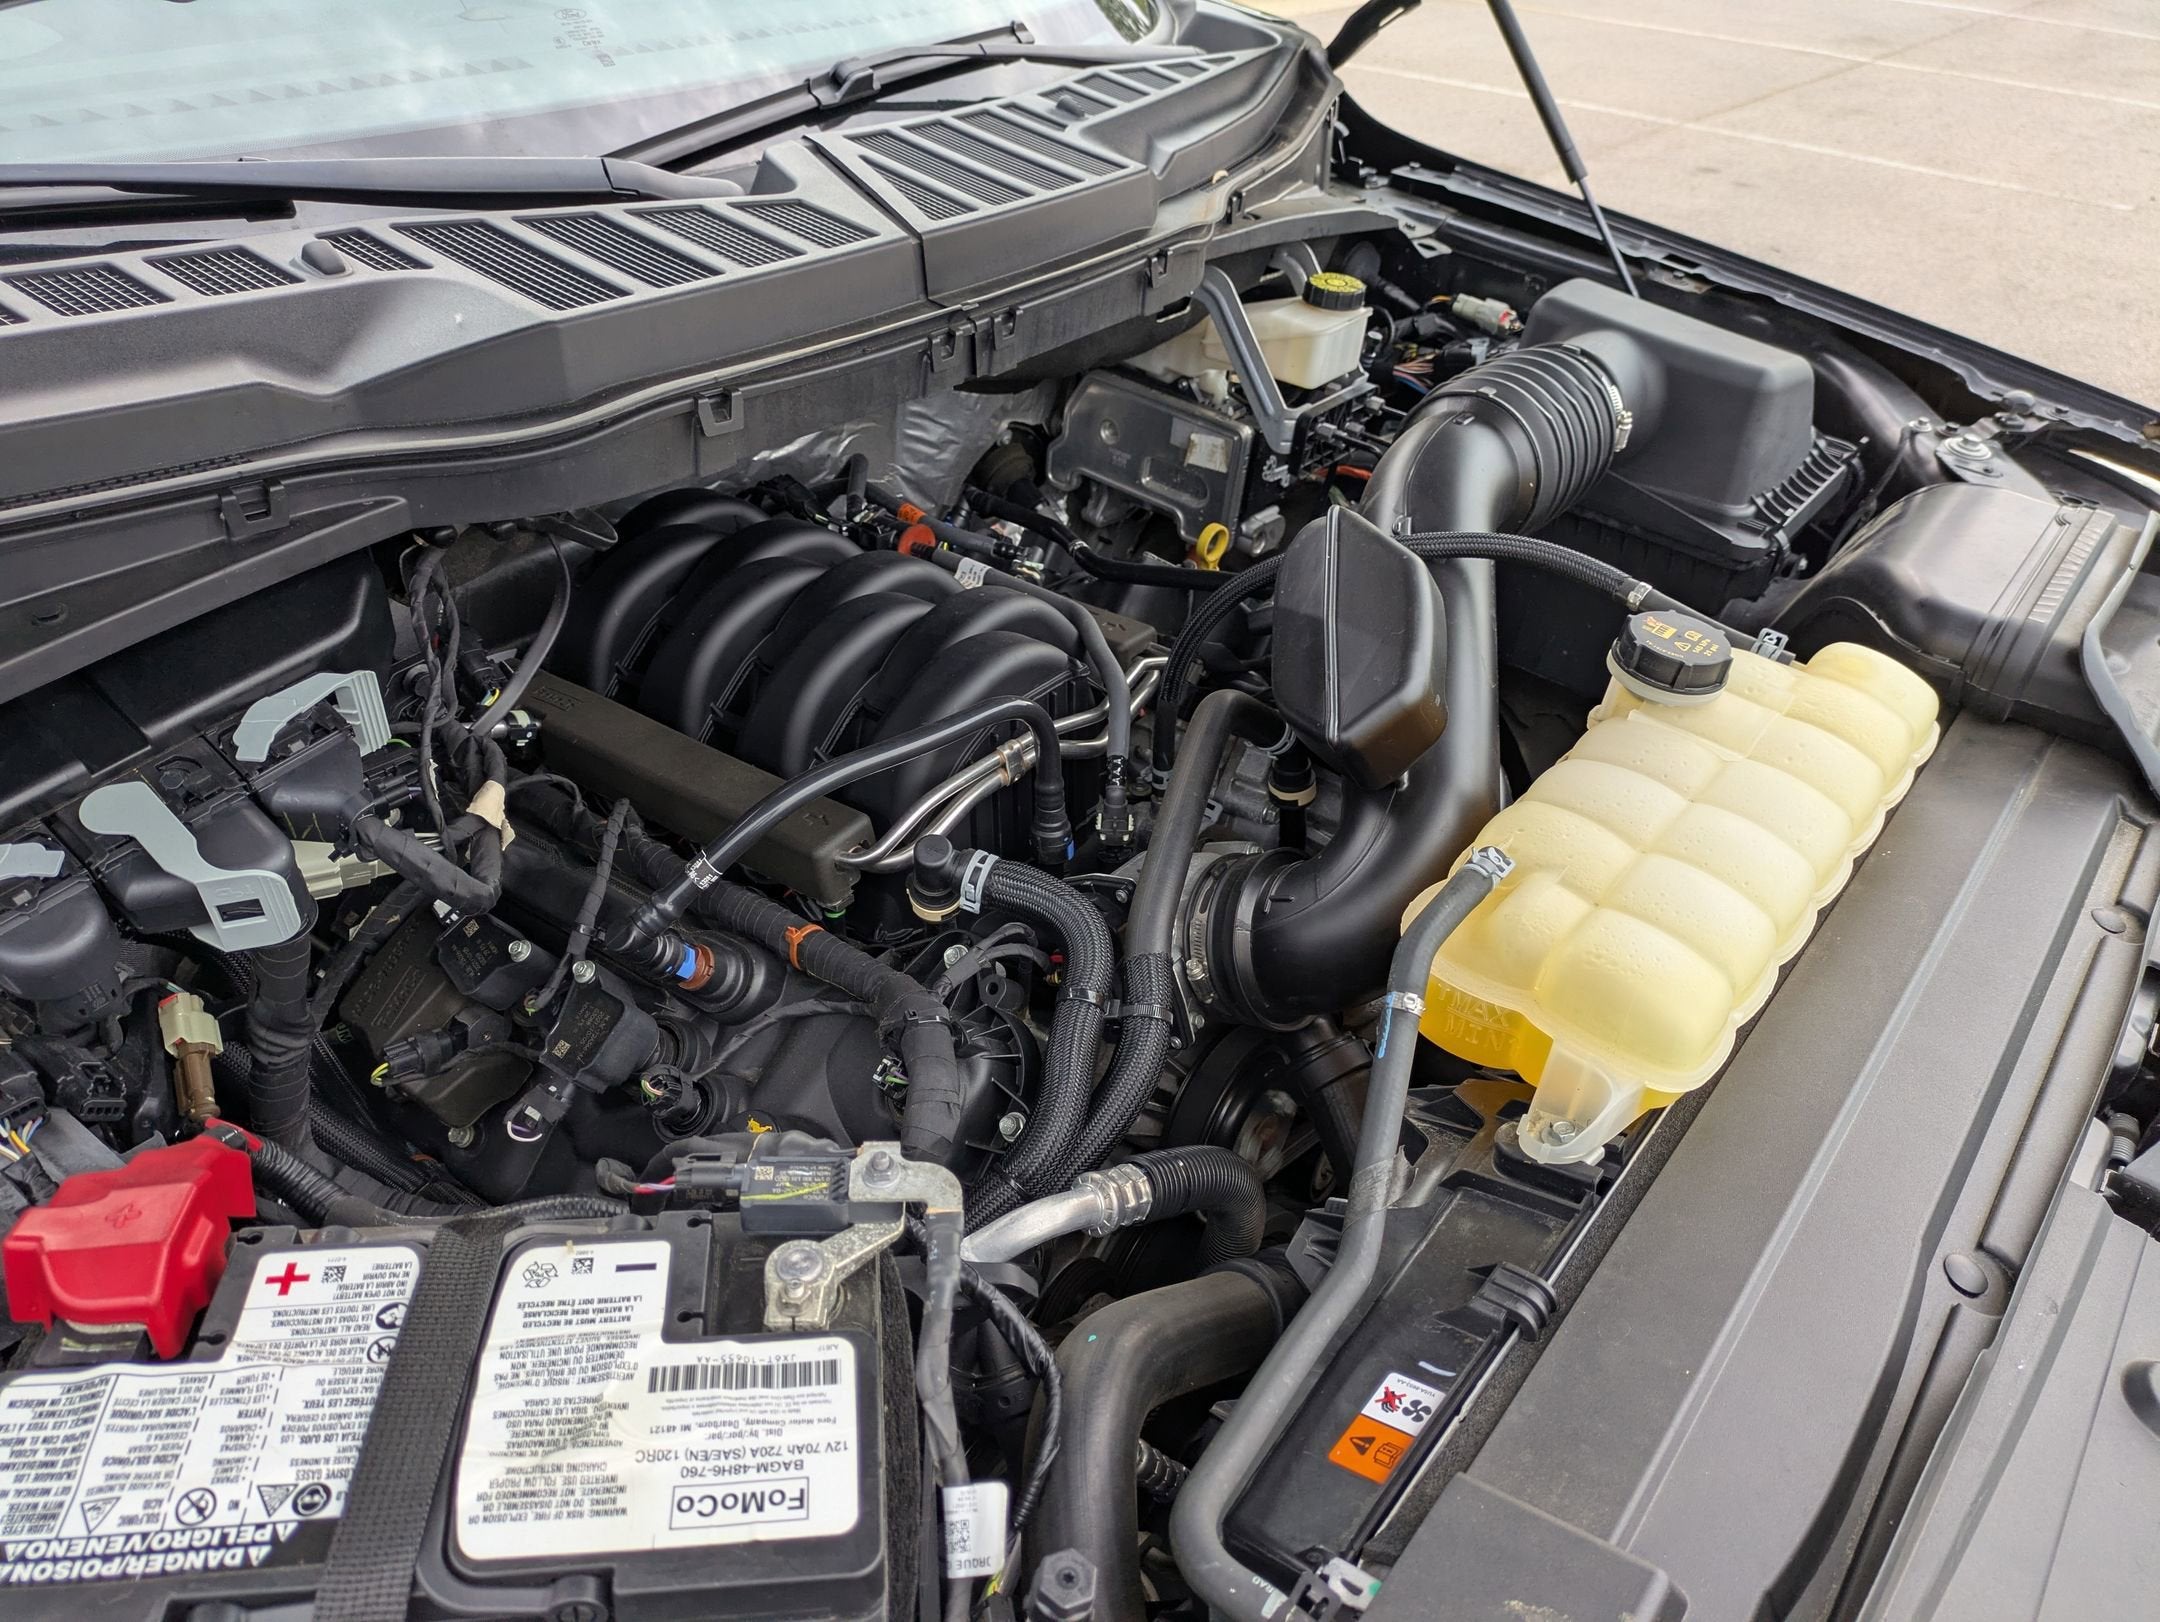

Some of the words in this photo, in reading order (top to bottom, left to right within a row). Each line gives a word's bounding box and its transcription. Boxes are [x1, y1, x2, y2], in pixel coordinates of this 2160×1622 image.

[1450, 992, 1509, 1026] MAX
[1443, 1014, 1505, 1051] MIN
[598, 1296, 631, 1304] BATTERIE
[336, 1305, 359, 1313] TOUTES
[361, 1304, 375, 1312] LIRE
[361, 1314, 373, 1322] LEA
[523, 1309, 568, 1318] RECICLARSE
[325, 1316, 337, 1324] LAS
[523, 1319, 561, 1328] RECYCLED
[576, 1317, 596, 1325] MUST
[599, 1315, 631, 1323] BATTERY
[548, 1347, 561, 1356] UNE
[564, 1346, 584, 1354] POUR
[573, 1355, 583, 1364] OU
[511, 1360, 526, 1370] NON
[567, 1367, 576, 1375] DE
[579, 1366, 588, 1374] OU
[494, 1372, 508, 1381] PAS
[511, 1372, 520, 1380] NE
[543, 1377, 569, 1386] RISQUE
[329, 1399, 343, 1407] LES
[237, 1408, 267, 1419] ÉVITER
[493, 1409, 552, 1419] INSTRUCCIONES
[555, 1408, 569, 1416] LAS
[572, 1407, 587, 1416] SIGA
[506, 1420, 521, 1428] USO
[525, 1419, 543, 1428] PARA
[743, 1417, 785, 1428] Company,
[789, 1418, 814, 1426] Motor
[817, 1417, 836, 1425] Ford
[650, 1425, 677, 1434] 48121
[679, 1424, 691, 1432] MI
[324, 1433, 338, 1442] LOS
[750, 1444, 782, 1456] 720A
[788, 1442, 820, 1454] 70Ah
[826, 1441, 848, 1452] 12V
[635, 1449, 678, 1462] 120RC
[685, 1446, 745, 1461] (SAE/EN)
[567, 1462, 607, 1472] CHARGING
[681, 1459, 803, 1478] BAGM-48H6-760
[489, 1478, 521, 1489] PROPER
[524, 1477, 556, 1487] FOLLOW
[580, 1475, 618, 1485] INVERTED
[476, 1492, 492, 1501] FOR
[495, 1489, 557, 1500] RECOMMENDED
[560, 1488, 576, 1497] NOT
[497, 1500, 552, 1511] DISASSEMBLE
[556, 1499, 571, 1508] NOT
[574, 1498, 584, 1507] DO
[590, 1497, 617, 1506] BURNS.
[677, 1488, 805, 1518] FoMoCo
[483, 1503, 494, 1512] OR
[554, 1511, 563, 1519] OF
[567, 1510, 584, 1519] RISK
[589, 1508, 627, 1518] WARNING:
[468, 1516, 479, 1524] OR
[483, 1513, 527, 1523] EXPLOSION
[26, 1524, 272, 1559] PELIGRO/VENENO
[12, 1547, 245, 1579] DANGER/POISON
